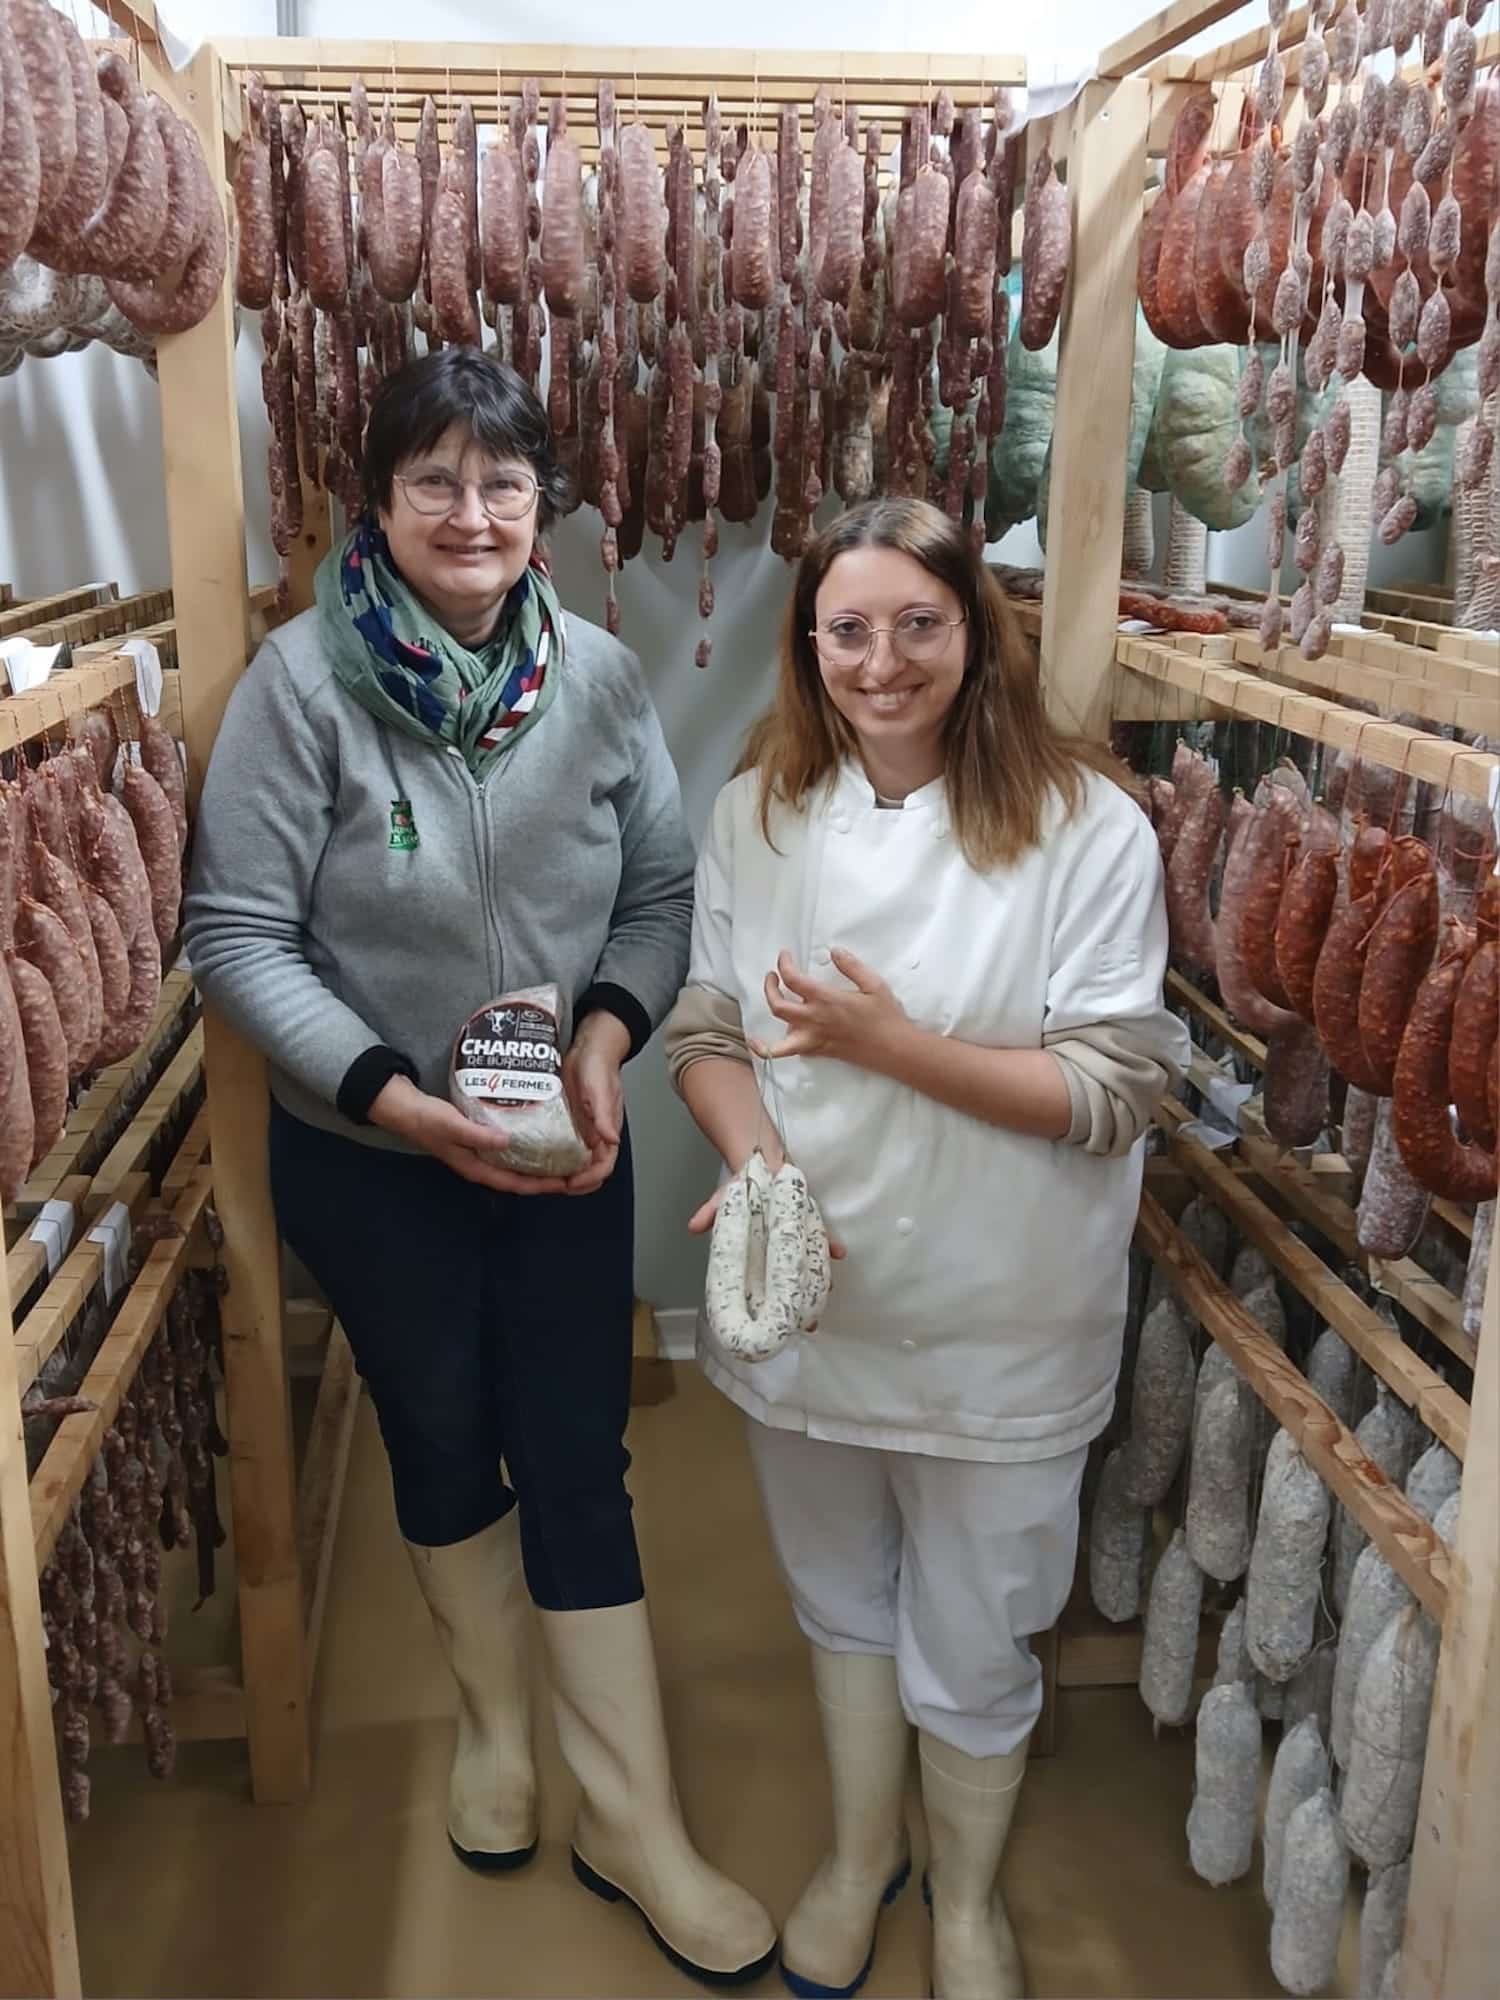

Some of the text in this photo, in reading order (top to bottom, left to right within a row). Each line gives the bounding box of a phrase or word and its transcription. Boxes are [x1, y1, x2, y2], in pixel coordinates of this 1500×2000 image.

[461, 1039, 561, 1068] CHARRON
[467, 1055, 484, 1066] DE
[464, 1073, 552, 1093] LES 4 FERMES
